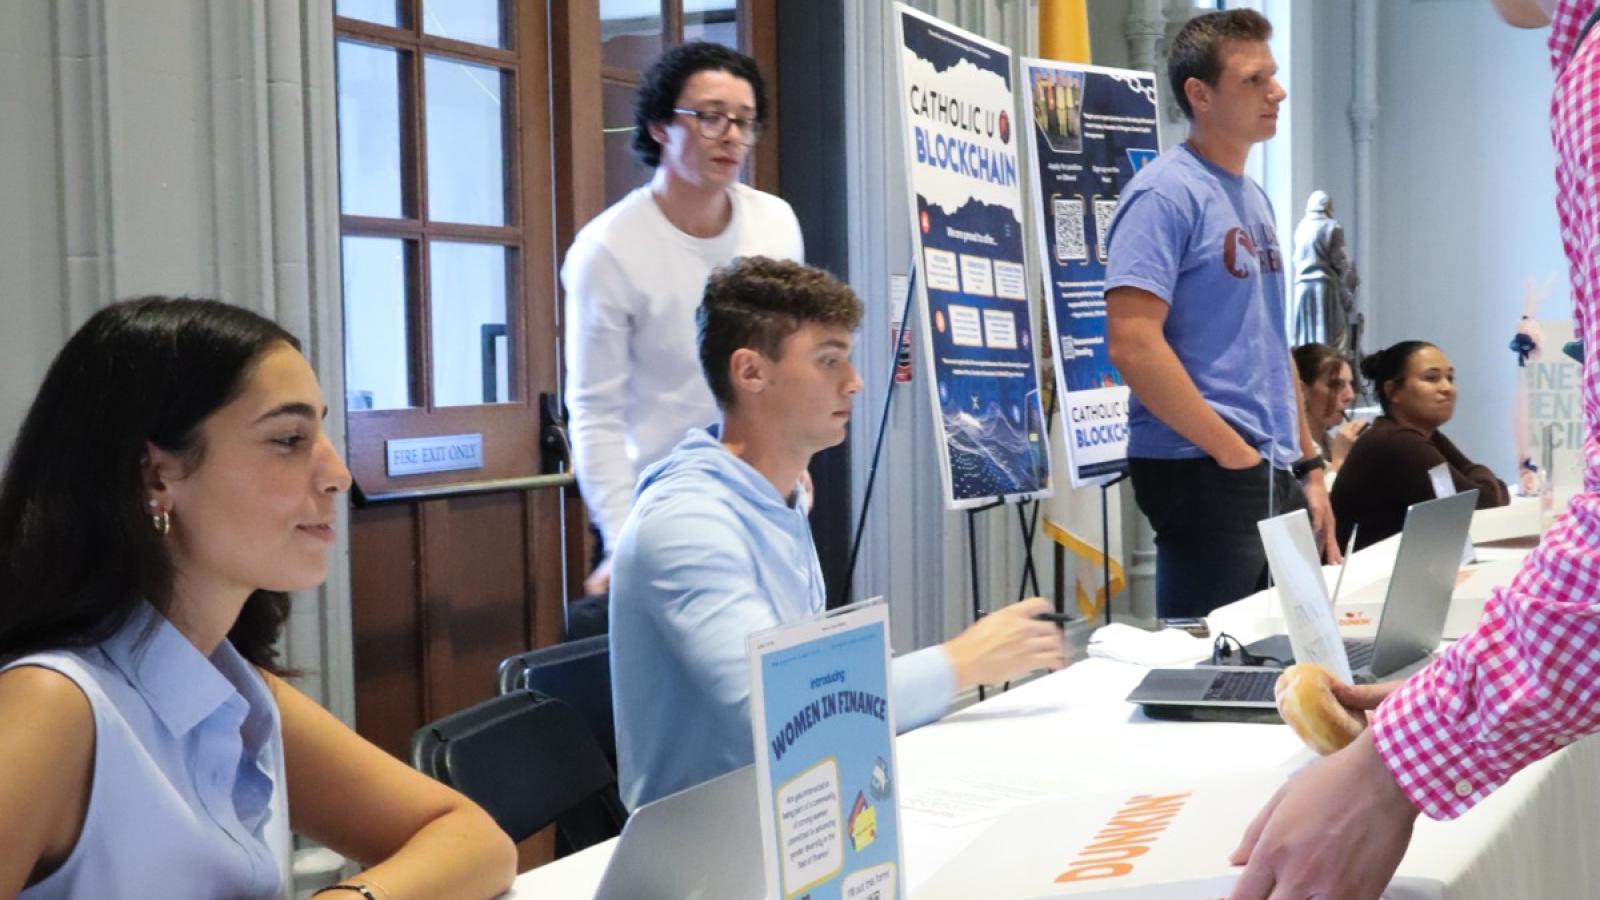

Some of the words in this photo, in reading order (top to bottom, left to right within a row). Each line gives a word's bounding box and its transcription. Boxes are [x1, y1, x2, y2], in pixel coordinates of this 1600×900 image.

[910, 85, 981, 138] CATHOLIC
[986, 111, 995, 138] U
[914, 126, 1017, 188] BLOCKCHAIN
[1071, 401, 1121, 423] CATHOLIC
[393, 448, 418, 465] FIRE
[422, 446, 446, 463] EXIT
[448, 443, 480, 461] ONLY
[810, 670, 845, 689] introducing
[772, 699, 820, 761] WOMEN
[822, 692, 837, 719] IN
[837, 690, 887, 721] FINANCE
